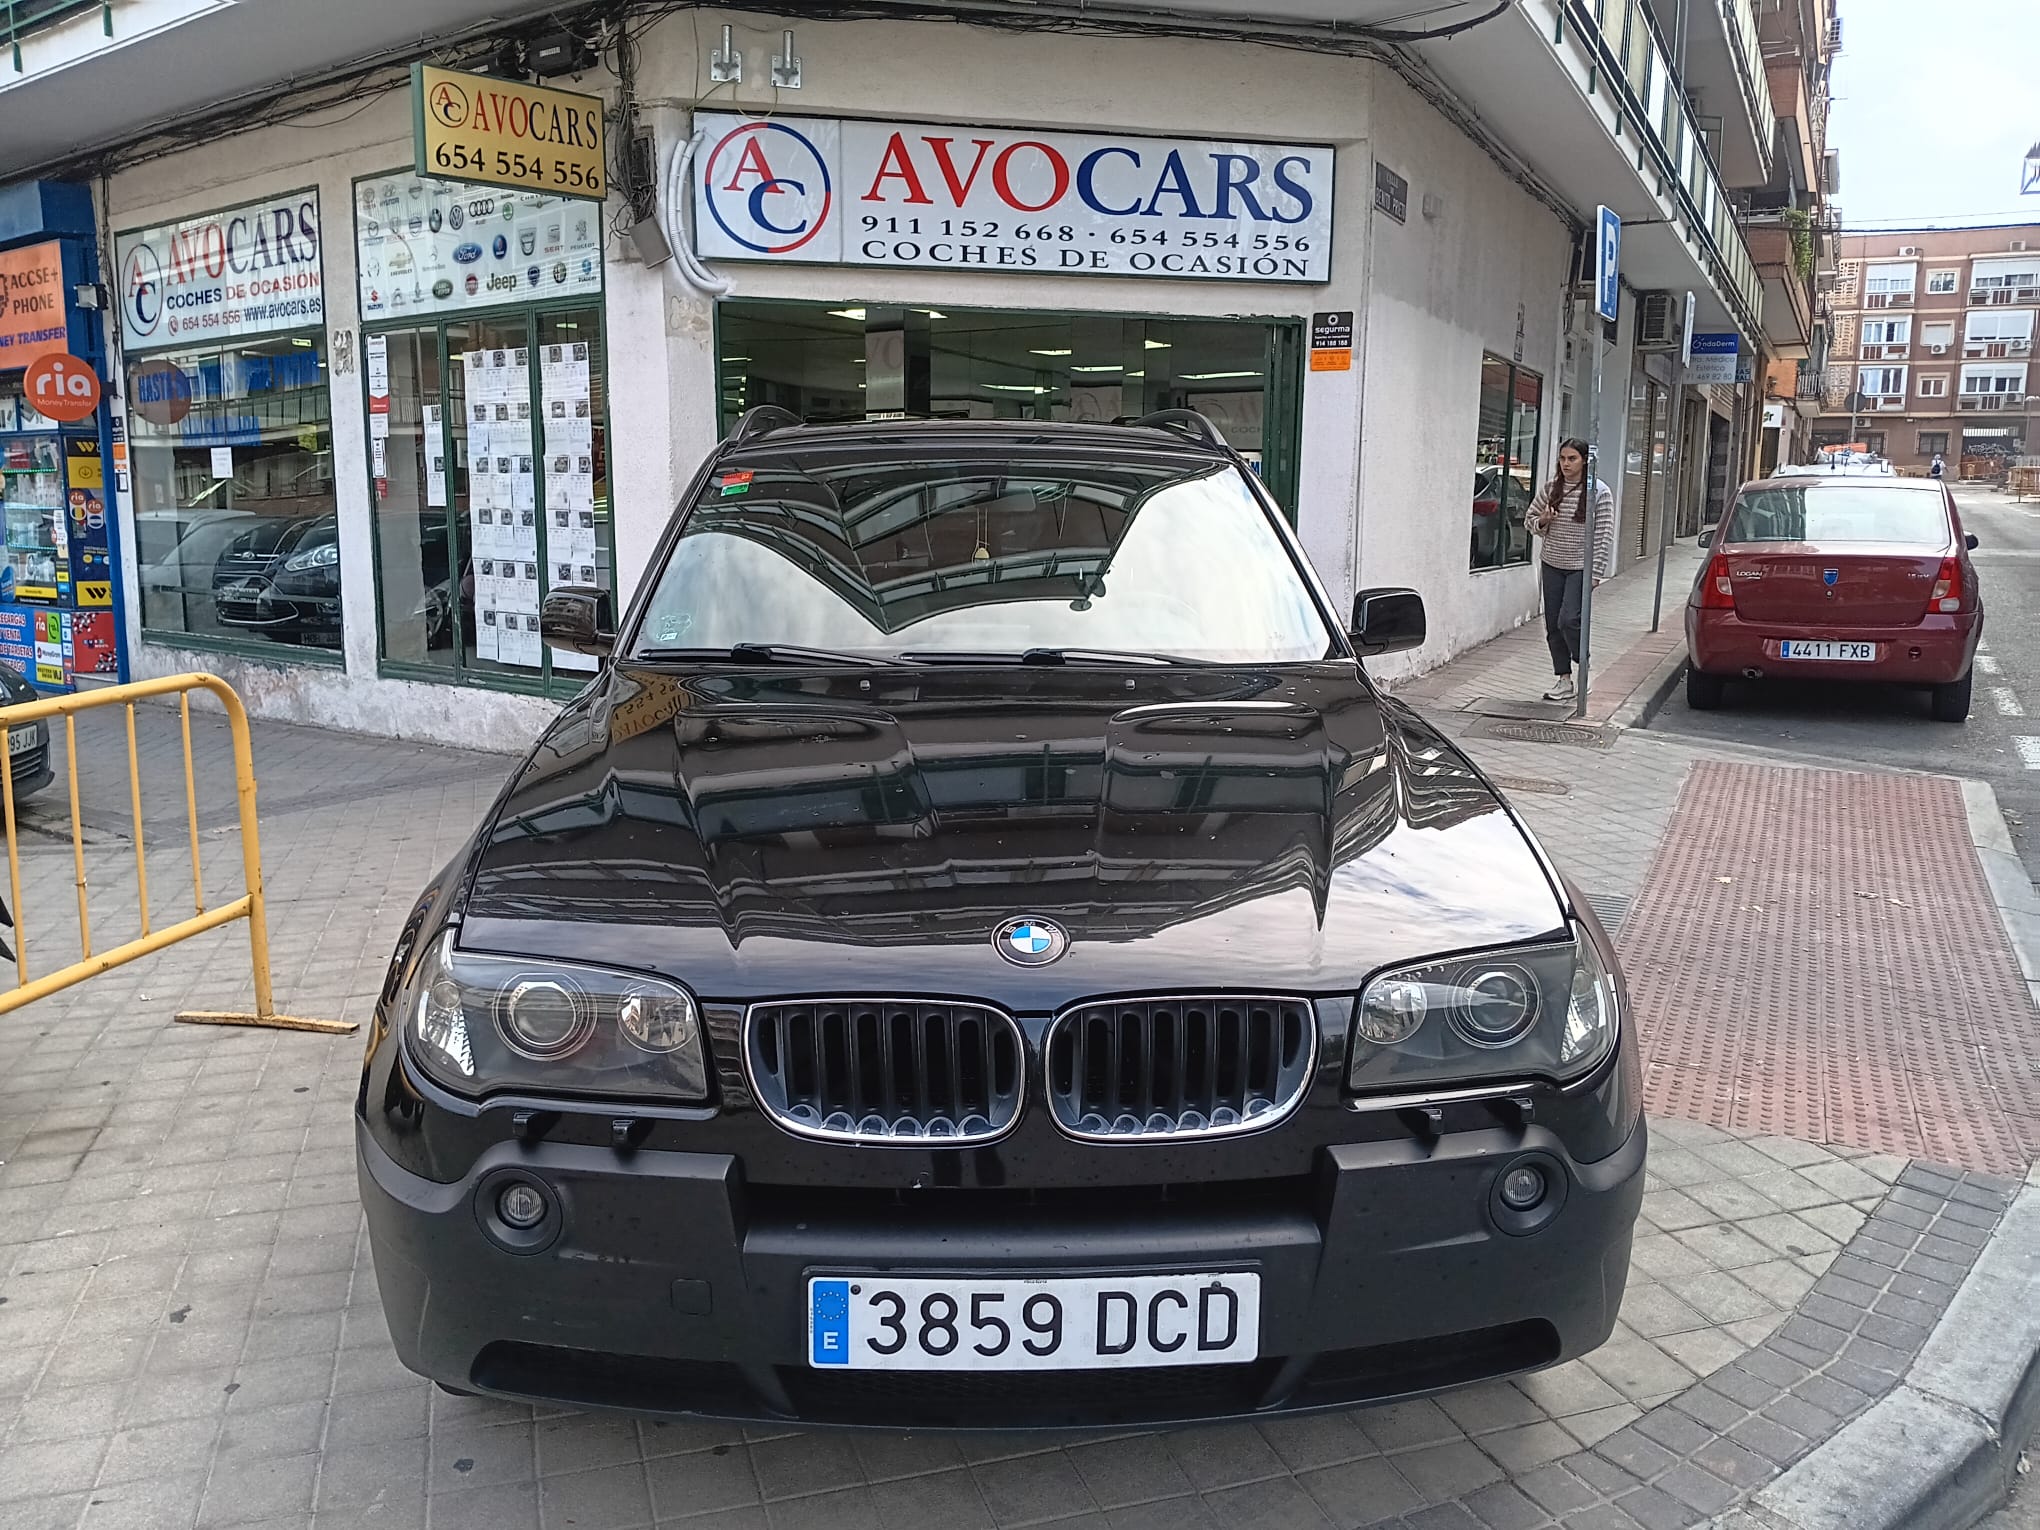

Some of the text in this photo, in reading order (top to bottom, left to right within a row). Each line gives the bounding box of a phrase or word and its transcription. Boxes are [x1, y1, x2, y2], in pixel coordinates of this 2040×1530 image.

[472, 90, 598, 150] AVOCARS
[435, 142, 599, 190] 654 554 556
[861, 131, 1313, 224] AVOCARS
[166, 202, 318, 287] AVOCARS
[861, 215, 1310, 252] 911 152 668 654 554 556
[861, 240, 1308, 277] COCHES DE OCASIÓN
[1604, 221, 1617, 304] P
[166, 271, 320, 310] COCHES DE OCASIÓN
[486, 272, 517, 292] Jeep
[13, 293, 55, 315] PHONE
[182, 296, 322, 331] 654 554 556 www.avocars.es
[17, 326, 66, 345] TRANSFER
[1315, 326, 1350, 335] segurma
[36, 361, 92, 398] ria
[37, 398, 62, 407] Money
[1793, 643, 1870, 658] 4411 FXB
[866, 1286, 1239, 1357] 3859 DCD
[823, 1331, 839, 1350] E
